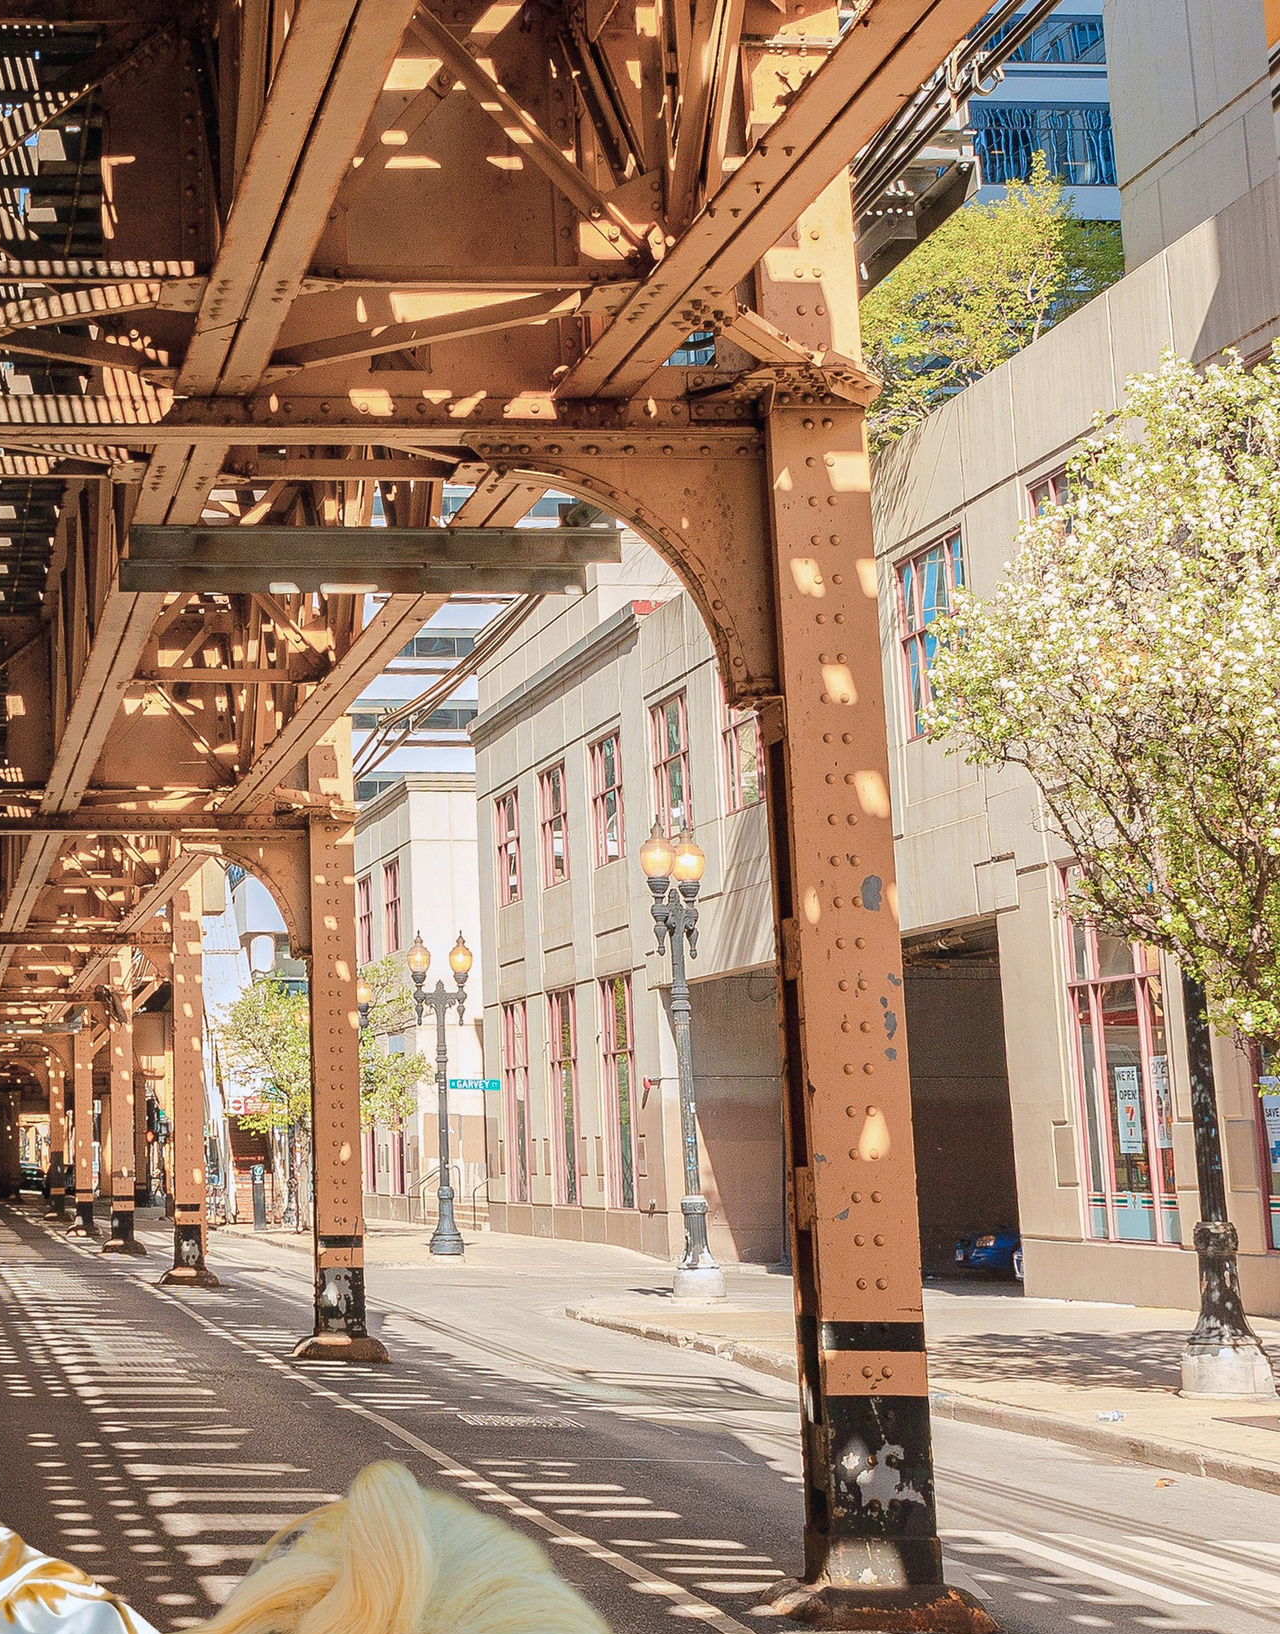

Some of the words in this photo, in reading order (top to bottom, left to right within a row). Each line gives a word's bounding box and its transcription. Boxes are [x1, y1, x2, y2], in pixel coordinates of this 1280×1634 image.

[1116, 1070, 1135, 1081] WE'RE
[456, 1080, 490, 1089] GARVEY
[1119, 1089, 1137, 1101] OPEN!
[1265, 1107, 1279, 1118] SAVE
